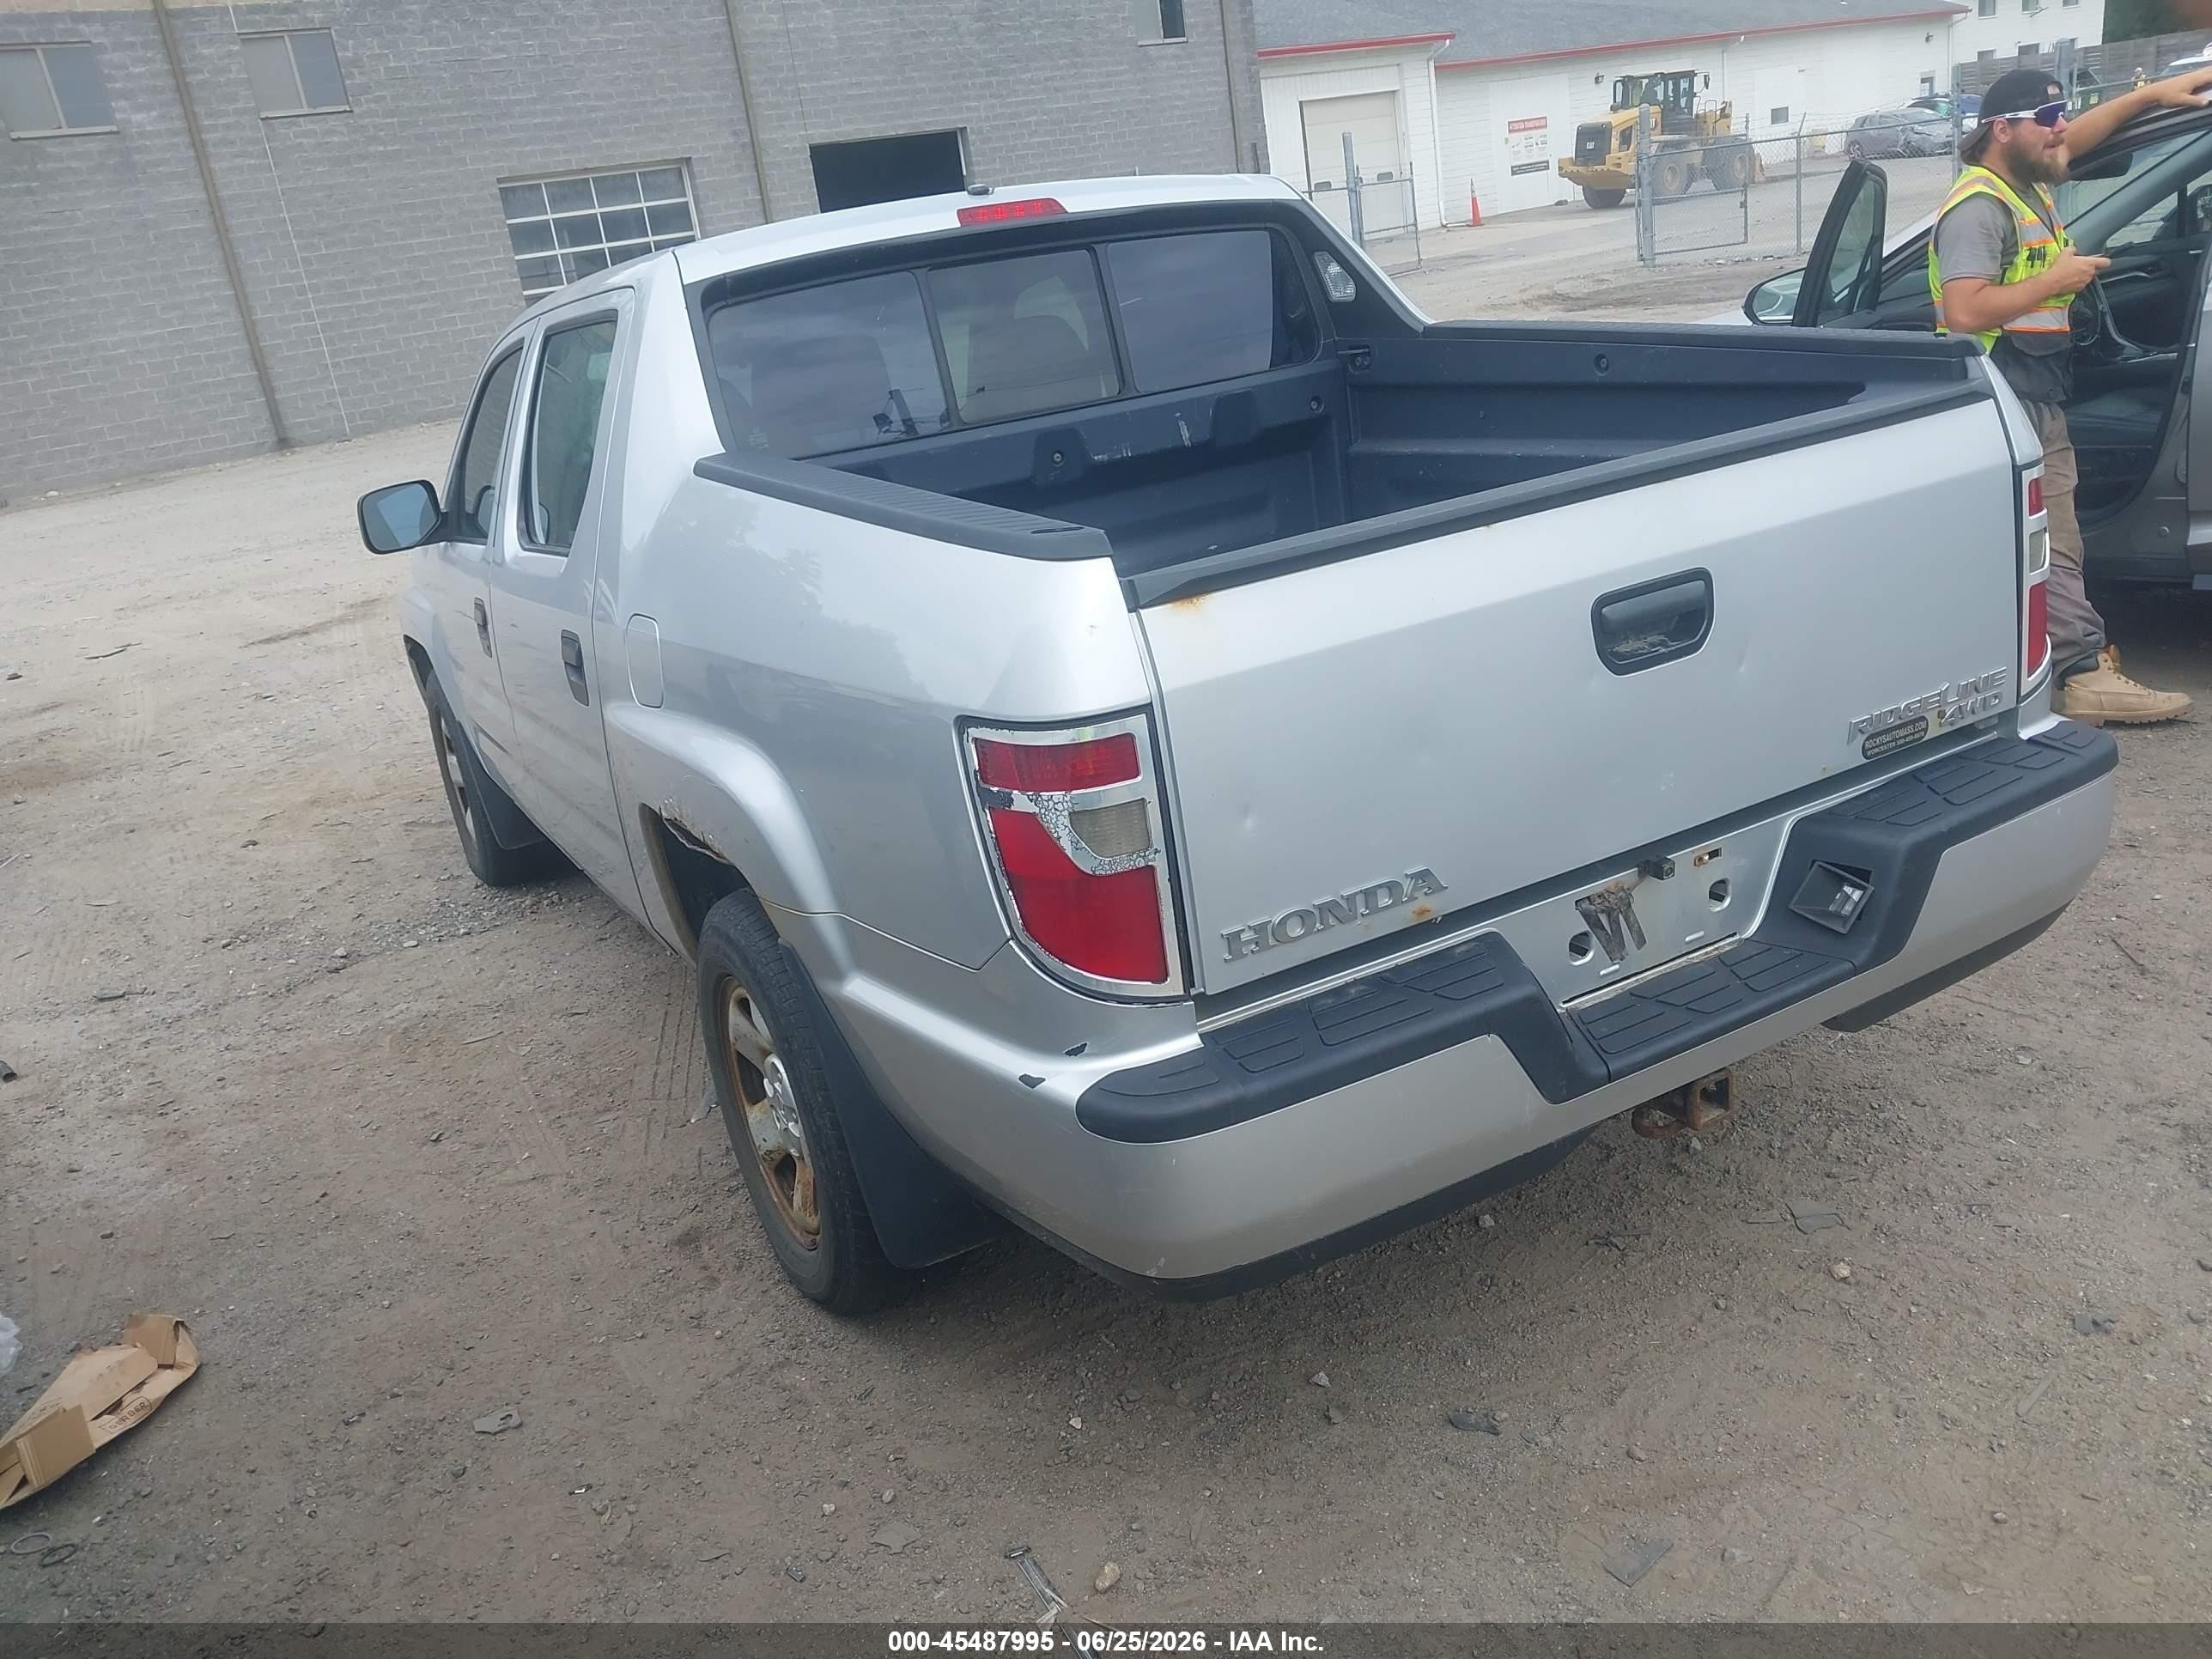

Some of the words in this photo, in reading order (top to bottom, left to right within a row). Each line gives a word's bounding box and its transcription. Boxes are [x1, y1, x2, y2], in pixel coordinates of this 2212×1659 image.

[1847, 666, 2007, 745] RIDGELINE
[1220, 866, 1449, 963] HONDA
[109, 1401, 149, 1429] GERBER
